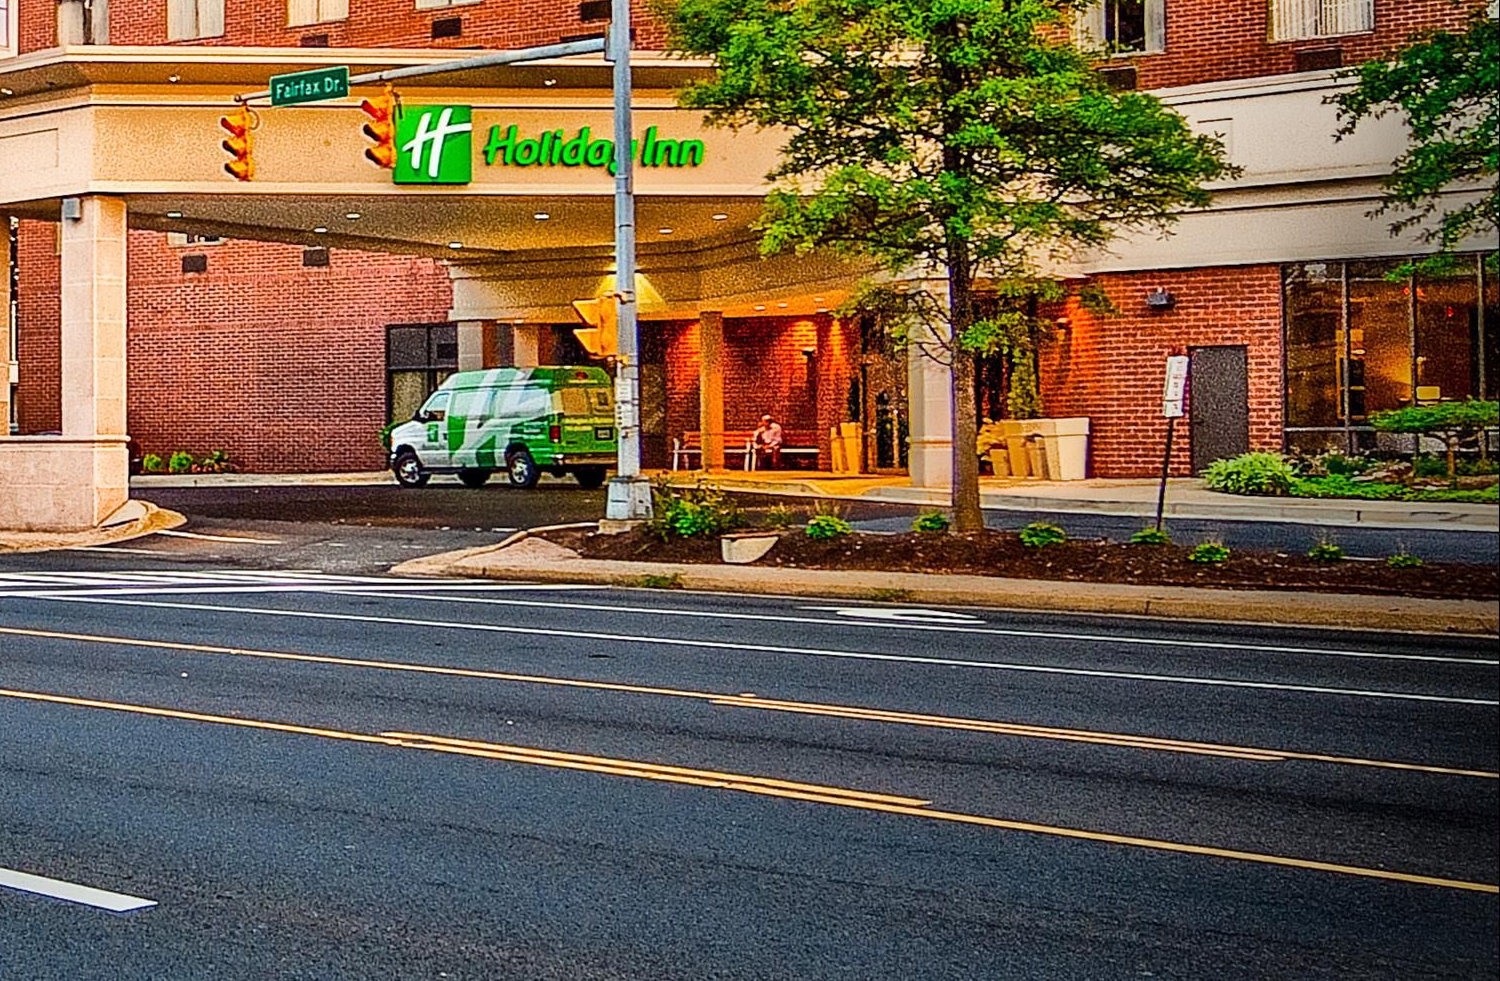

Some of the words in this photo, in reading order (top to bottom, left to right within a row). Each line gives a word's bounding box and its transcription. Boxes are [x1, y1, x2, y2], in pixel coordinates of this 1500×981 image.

[275, 80, 320, 99] Fairfax
[323, 76, 344, 93] Dr.
[641, 125, 705, 167] Inn
